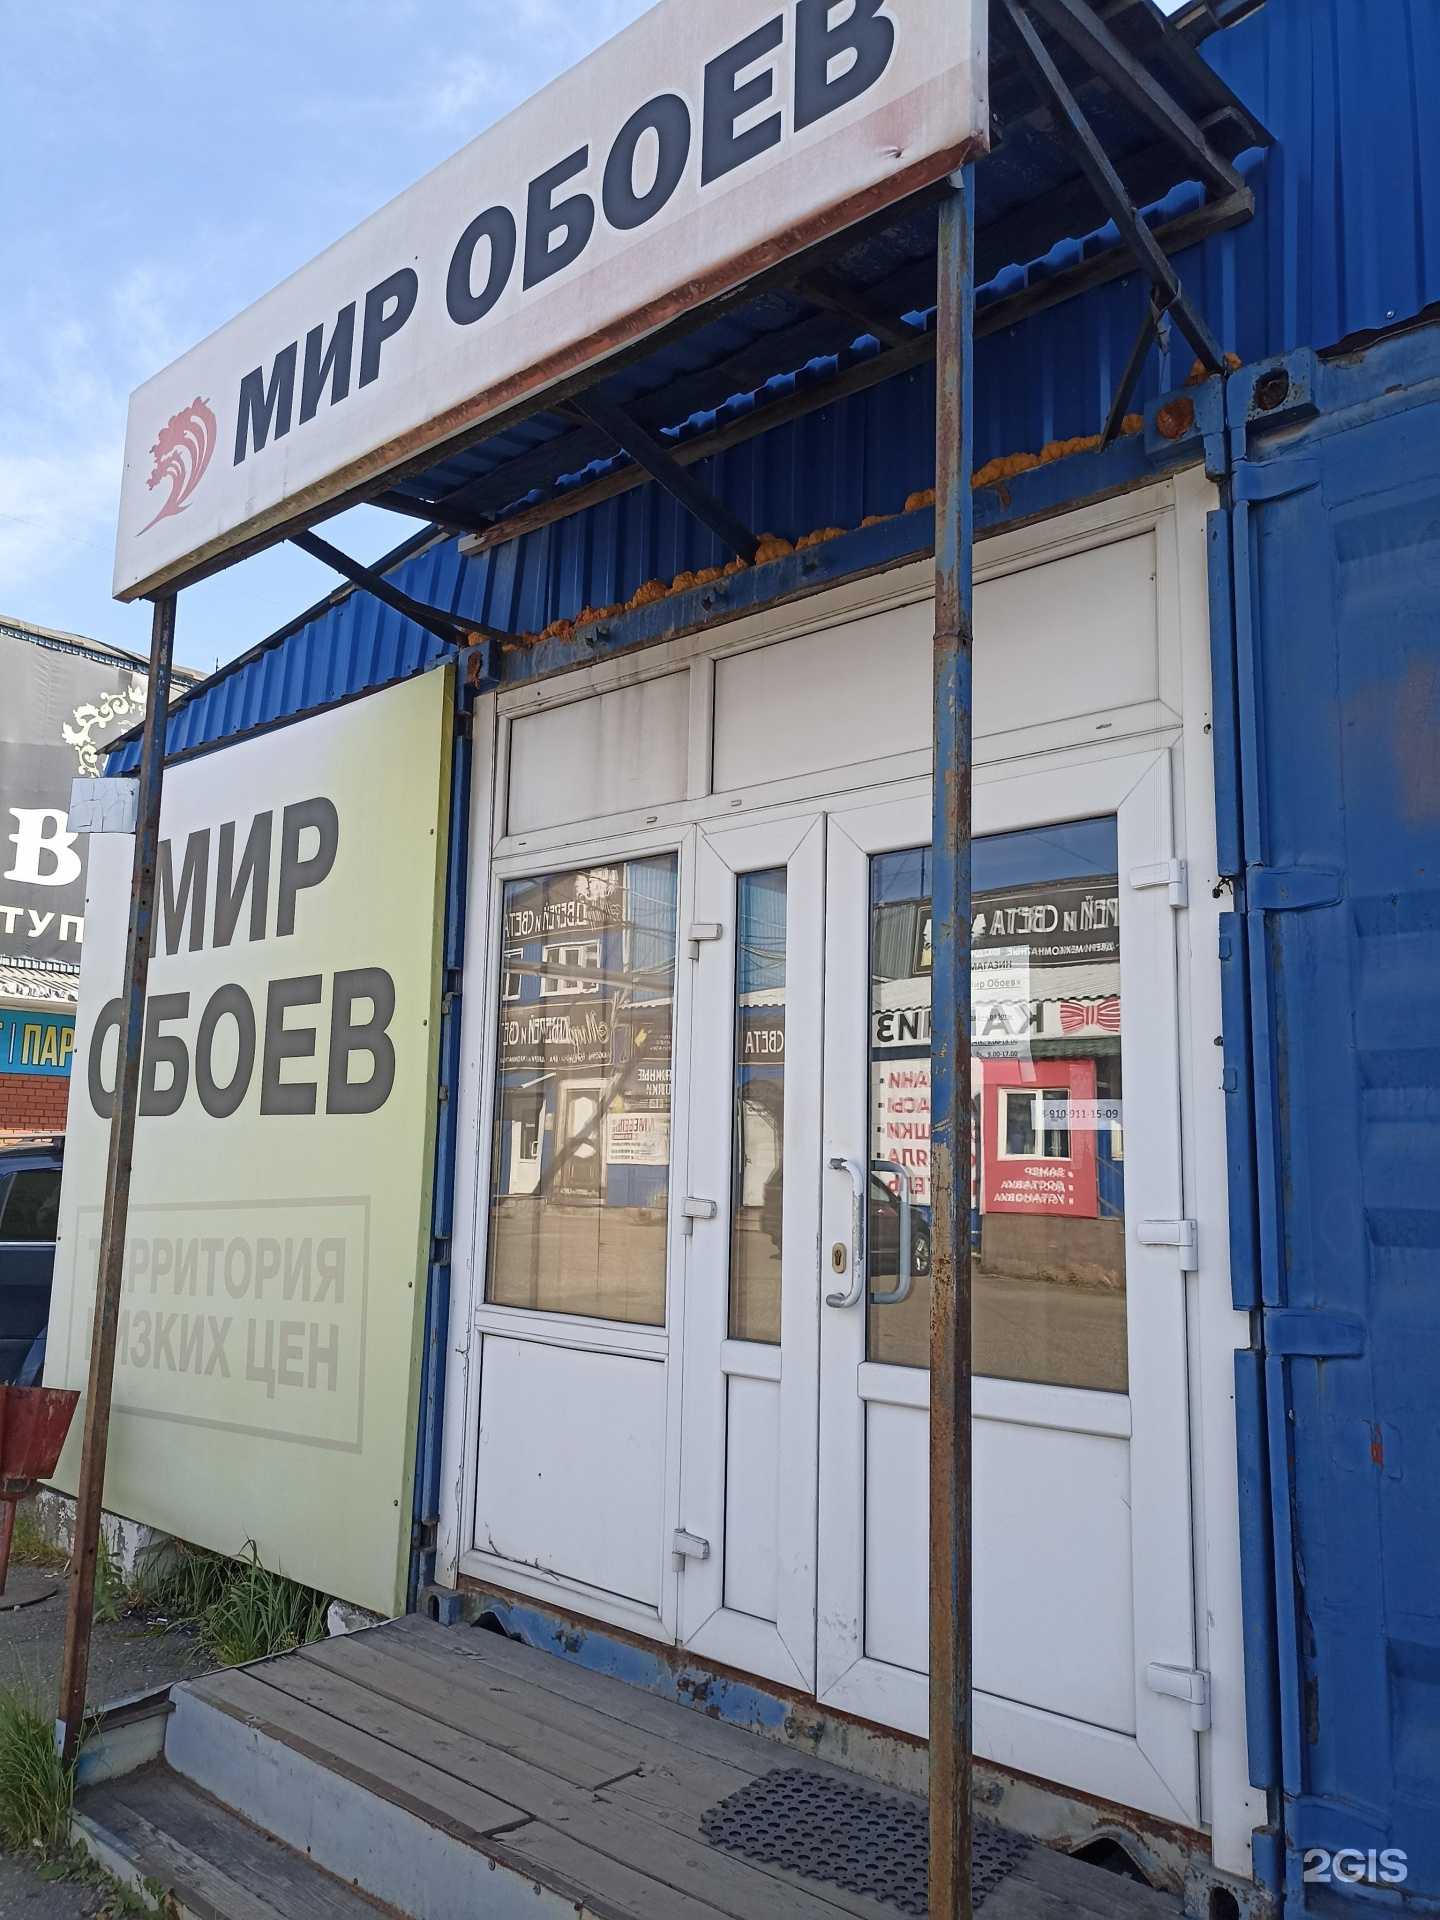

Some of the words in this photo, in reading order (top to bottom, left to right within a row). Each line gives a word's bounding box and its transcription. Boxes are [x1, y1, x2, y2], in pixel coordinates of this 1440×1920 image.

[233, 267, 419, 467] МИР
[446, 0, 896, 326] ОБОЕВ
[150, 796, 339, 959] МИР
[22, 1024, 75, 1067] ПАР
[87, 966, 396, 1120] ОБОЕВ
[88, 1235, 347, 1304] ТРРИТОРИЯ
[85, 1307, 232, 1378] ИЗКИХ
[245, 1318, 339, 1399] ЦЕН
